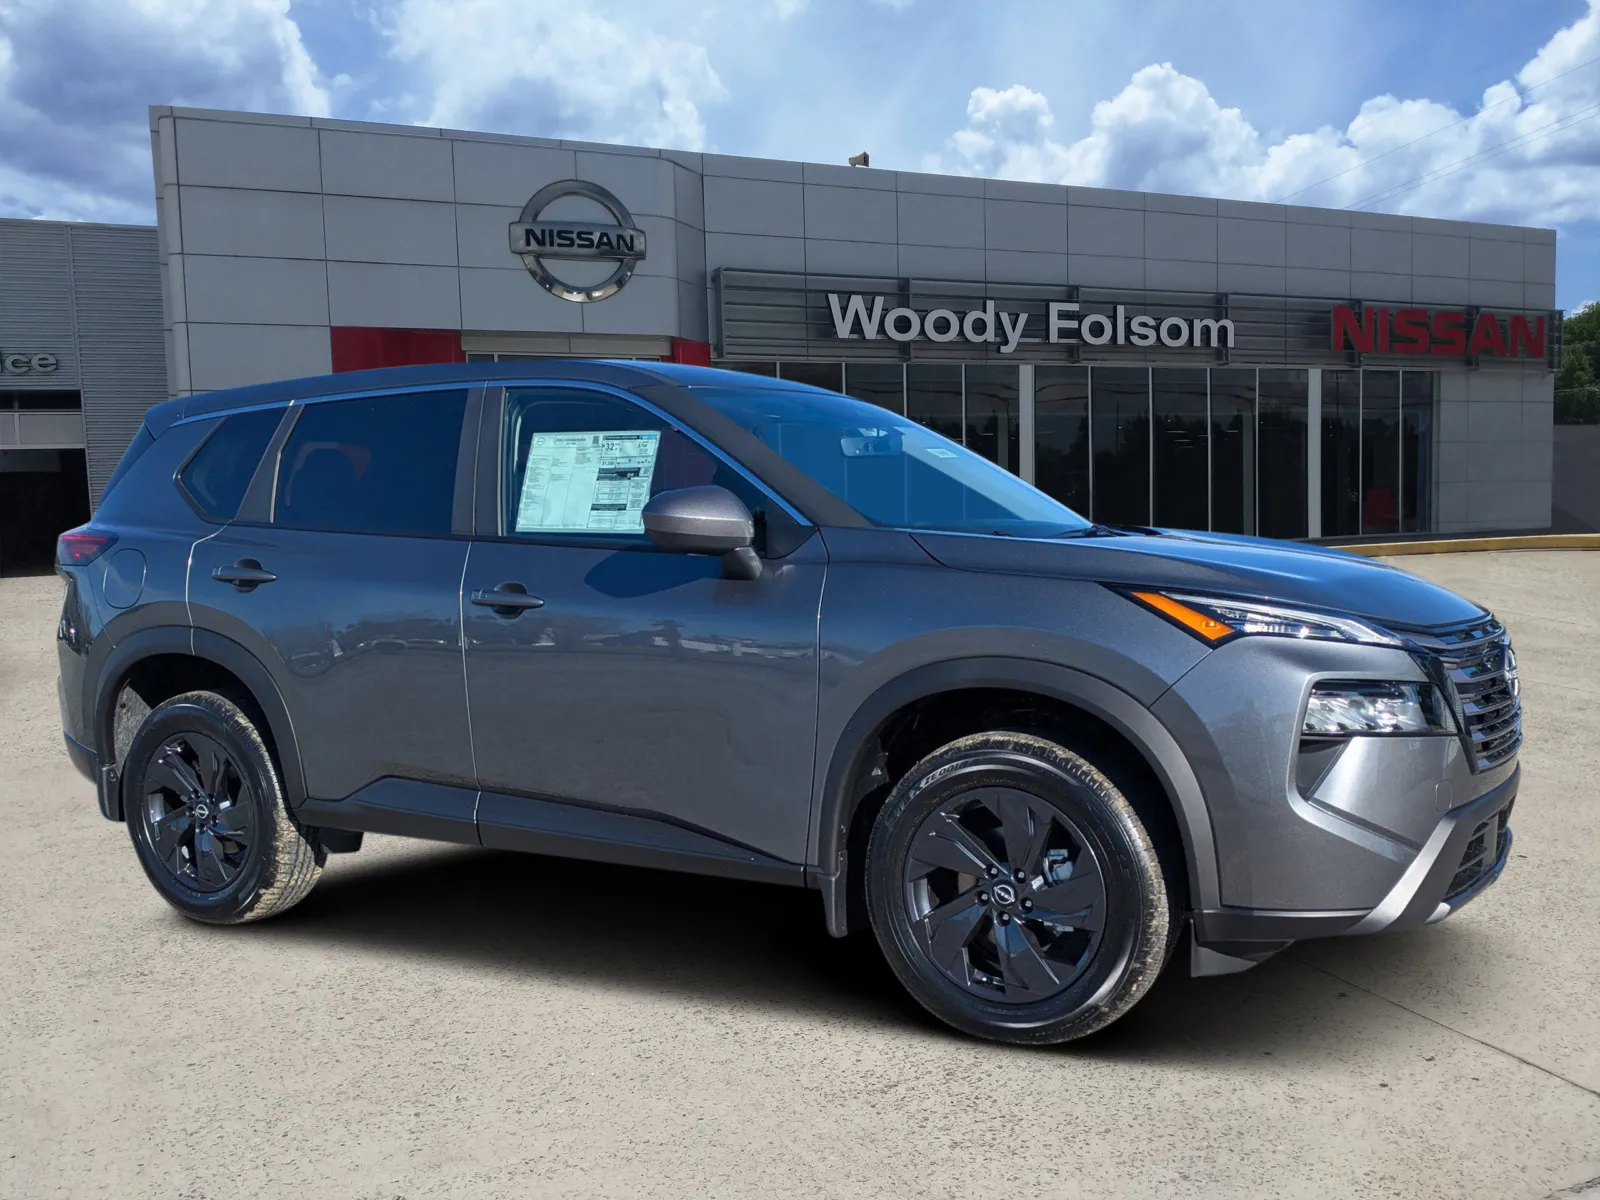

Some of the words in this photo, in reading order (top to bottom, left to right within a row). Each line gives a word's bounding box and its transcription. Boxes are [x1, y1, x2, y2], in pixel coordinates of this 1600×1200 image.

[525, 228, 635, 252] NISSAN
[827, 293, 1028, 353] Woody
[1048, 302, 1235, 348] Folsom
[1333, 305, 1545, 358] NISSAN
[0, 353, 57, 374] ce
